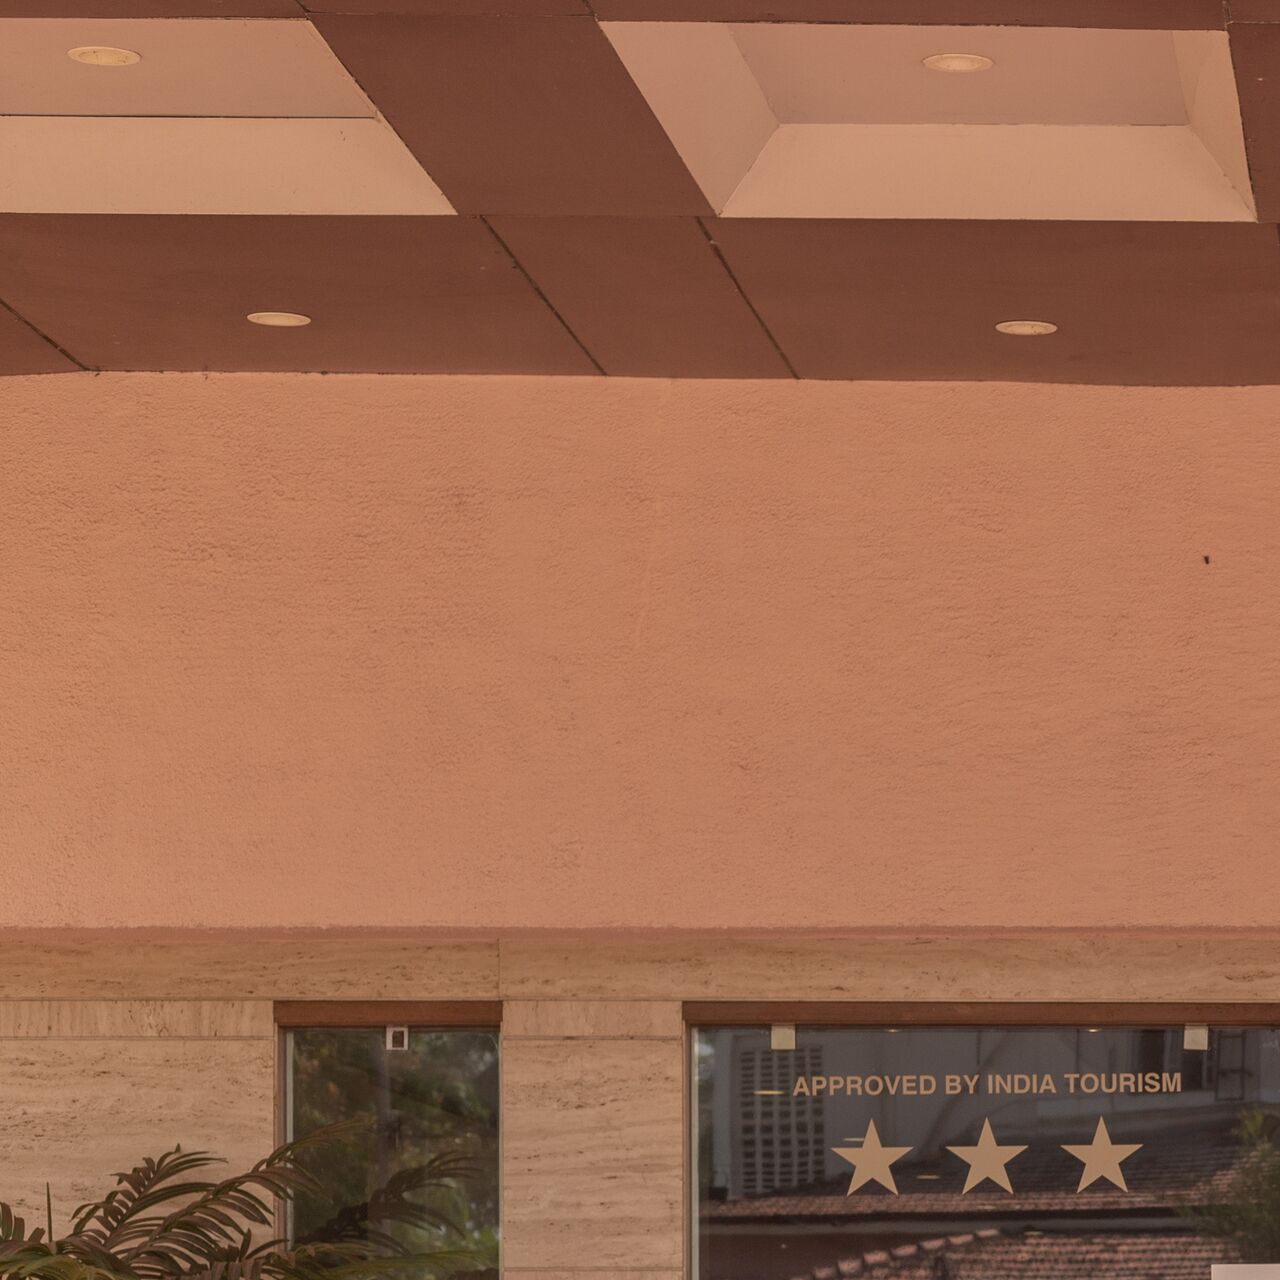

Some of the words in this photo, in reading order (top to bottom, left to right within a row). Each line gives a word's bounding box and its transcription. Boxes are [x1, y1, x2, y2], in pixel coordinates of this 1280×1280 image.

[793, 1075, 937, 1097] APPROVED
[944, 1075, 981, 1096] BY
[987, 1074, 1056, 1095] INDIA
[1064, 1072, 1182, 1094] TOURISM
